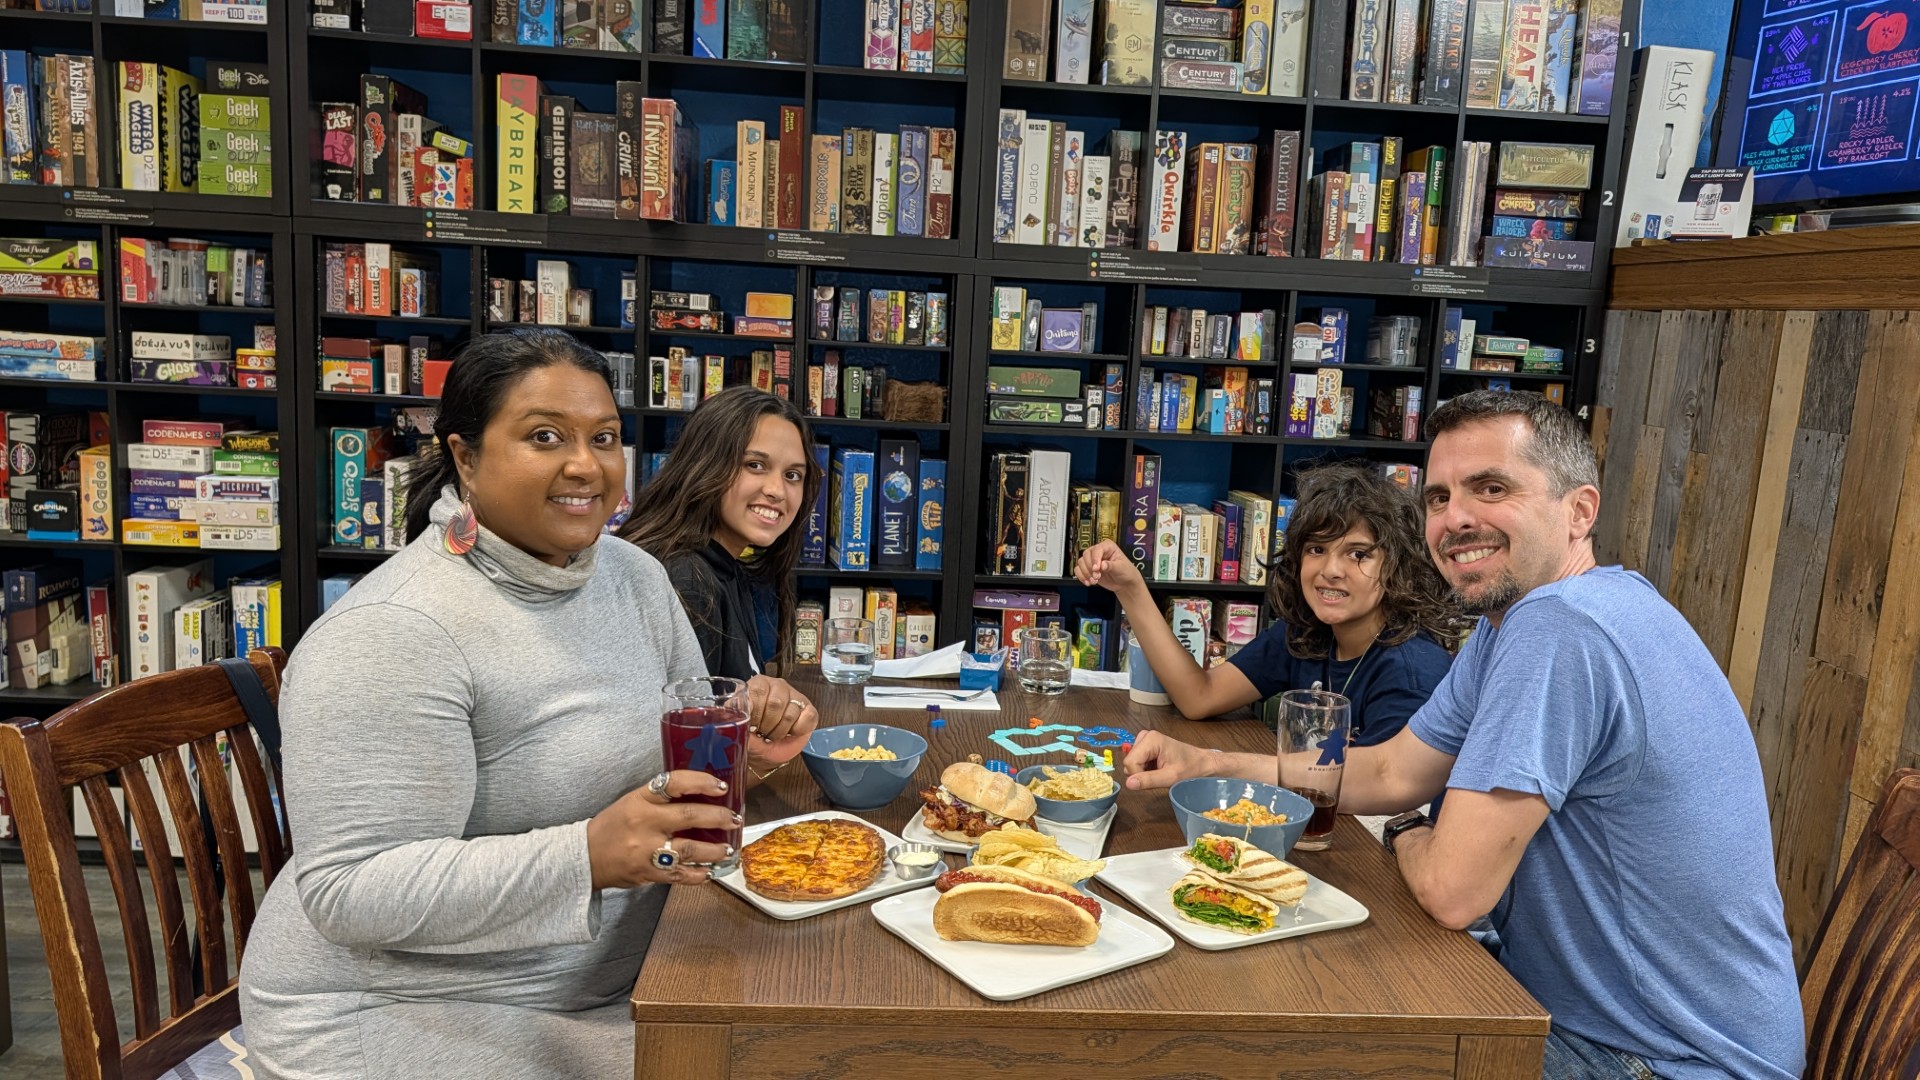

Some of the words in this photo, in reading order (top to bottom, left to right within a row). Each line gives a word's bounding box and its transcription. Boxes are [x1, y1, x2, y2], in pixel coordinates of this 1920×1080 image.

[229, 8, 244, 19] 100
[914, 0, 923, 28] AZUL
[1173, 12, 1218, 26] CENTURY
[1515, 4, 1542, 83] HEAT
[1623, 33, 1630, 47] 1
[1164, 43, 1218, 58] CENTURY
[1840, 55, 1885, 70] LEGENDARY
[1888, 49, 1920, 60] CHERRY
[1840, 67, 1864, 77] CIDER
[1879, 57, 1919, 70] SLABTOWN
[217, 67, 241, 82] Geek
[1179, 66, 1226, 79] CENTURY
[1665, 61, 1694, 111] KLASK
[1892, 87, 1911, 97] 4.2%
[226, 98, 259, 118] Geek
[328, 110, 346, 119] DEAD
[130, 101, 141, 153] WAGERS
[326, 117, 352, 130] LAST
[72, 131, 85, 156] 1941
[181, 89, 193, 186] WAGERS
[226, 132, 259, 151] Geek
[509, 78, 526, 211] DAYBREAK
[1838, 139, 1863, 149] ROCKY
[1866, 136, 1895, 146] RADLER
[552, 105, 566, 190] HORRIFIED
[619, 131, 632, 178] CRIME
[643, 113, 666, 199] JUMANJI
[1743, 151, 1758, 160] ALES
[1759, 149, 1775, 158] FROM
[1777, 147, 1789, 155] THE
[1790, 143, 1813, 154] CRYPT
[1827, 145, 1872, 158] CRANBERRY
[1874, 142, 1904, 152] RADLER
[1762, 160, 1799, 171] CHRONICLE
[1765, 155, 1791, 164] CURRANT
[1791, 153, 1806, 161] SOUR
[1838, 155, 1849, 163] BY
[1850, 151, 1890, 162] BANCROFT
[225, 164, 258, 184] Geek
[746, 150, 758, 202] MUNCHKIN
[1276, 134, 1292, 212] DECEPTION
[1433, 160, 1443, 192] Blokus
[814, 152, 830, 216] MICROPOLIS
[845, 166, 858, 198] SHIP
[853, 163, 866, 201] SHAPE
[932, 178, 943, 193] H2
[1160, 171, 1180, 234] Qwirkle
[1499, 200, 1536, 212] COMFORTS
[1602, 190, 1614, 206] 2
[1327, 187, 1340, 241] PATCHWORK
[1408, 213, 1419, 238] Blokus
[1499, 218, 1526, 228] WRECK
[1495, 227, 1527, 238] RAIDERS
[1500, 249, 1577, 260] KUIPERIUM
[369, 265, 380, 280] E3
[348, 279, 356, 296] THE
[1045, 328, 1079, 340] Onitama
[1216, 319, 1224, 346] ANTIDOTE
[1324, 328, 1332, 342] NO
[169, 341, 184, 349] VU
[1584, 338, 1595, 353] 3
[157, 361, 198, 380] GHOST
[1105, 403, 1115, 426] FOOD
[1577, 405, 1588, 419] 4
[147, 429, 204, 440] CODENAMES
[152, 448, 167, 460] D5
[134, 478, 176, 488] CODENAMES
[221, 482, 260, 492] DECRYPTO
[341, 460, 359, 513] Quelf
[33, 503, 68, 513] CRANIUM
[168, 499, 184, 509] D5
[921, 500, 931, 532] CAPTAIN
[930, 501, 943, 529] FLIP
[1035, 477, 1051, 554] ARCHITECTS
[237, 529, 253, 540] D5
[882, 510, 904, 556] PLANET
[1080, 520, 1091, 550] DUEL
[1187, 523, 1199, 553] TREK
[1227, 522, 1236, 549] LONDON
[984, 595, 1008, 605] Canvas
[94, 613, 106, 657] MANCALA
[908, 624, 932, 632] CALICO
